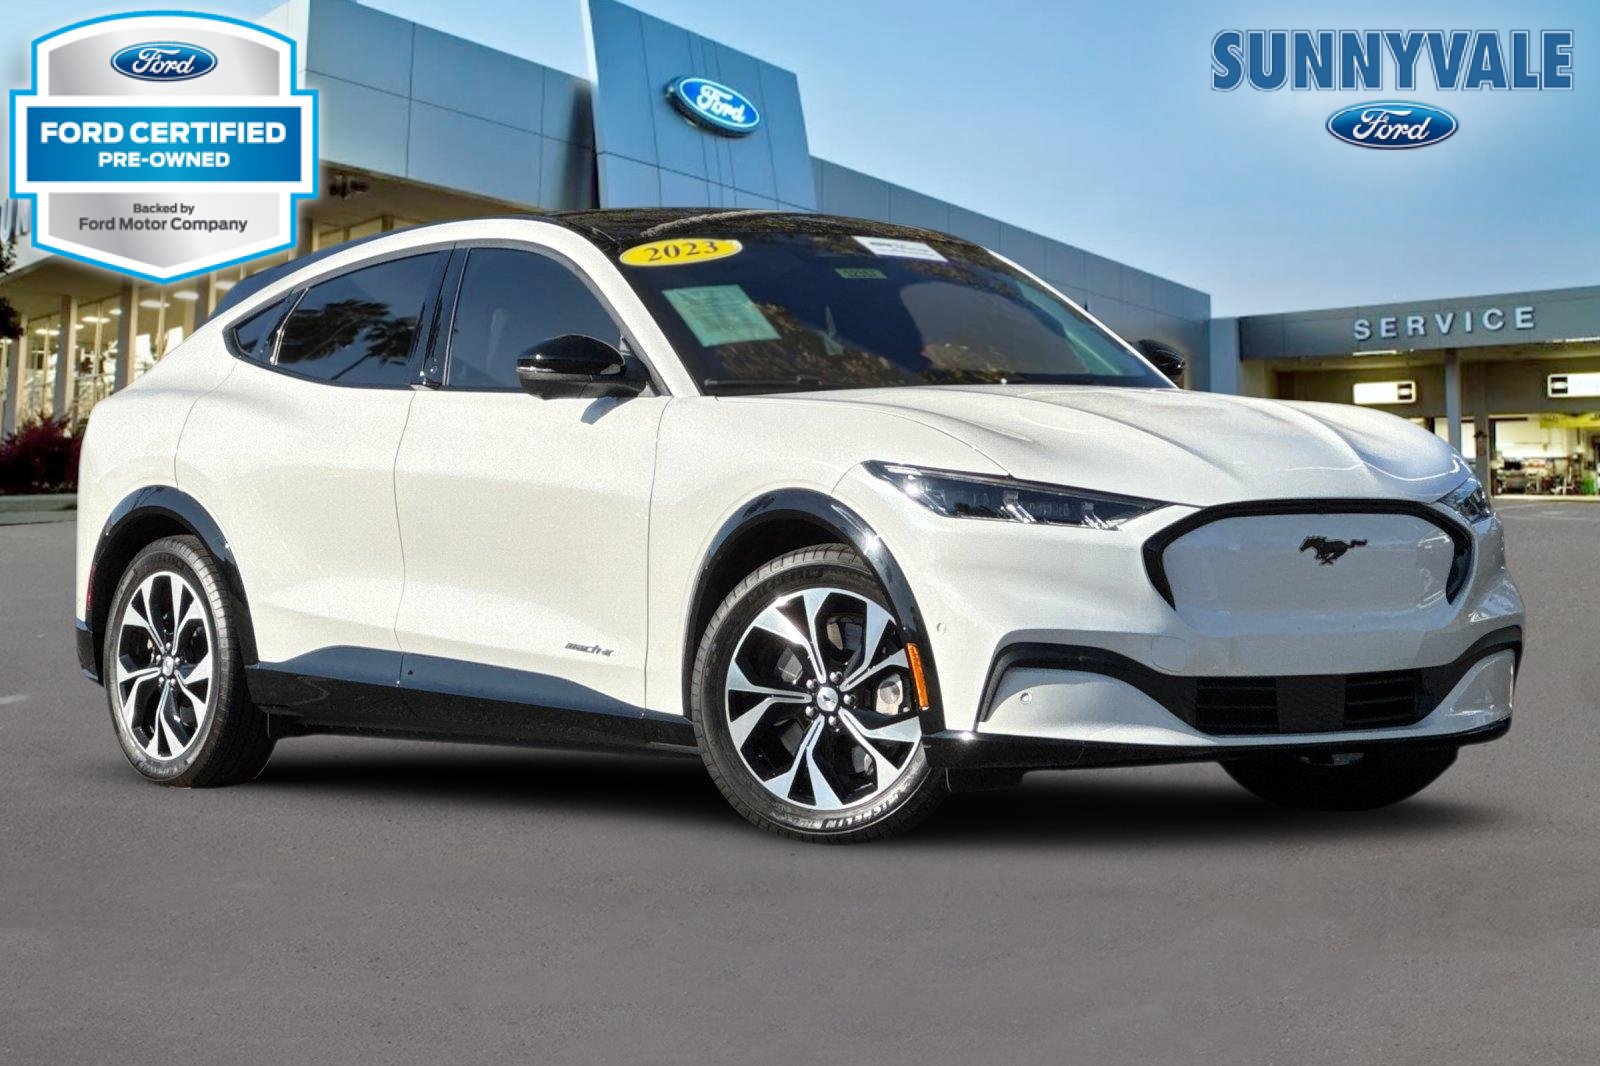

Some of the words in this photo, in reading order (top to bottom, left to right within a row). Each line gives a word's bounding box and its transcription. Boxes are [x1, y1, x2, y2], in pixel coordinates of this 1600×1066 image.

[696, 84, 746, 123] Ford
[644, 240, 719, 262] 2023
[1353, 305, 1536, 341] SERVICE
